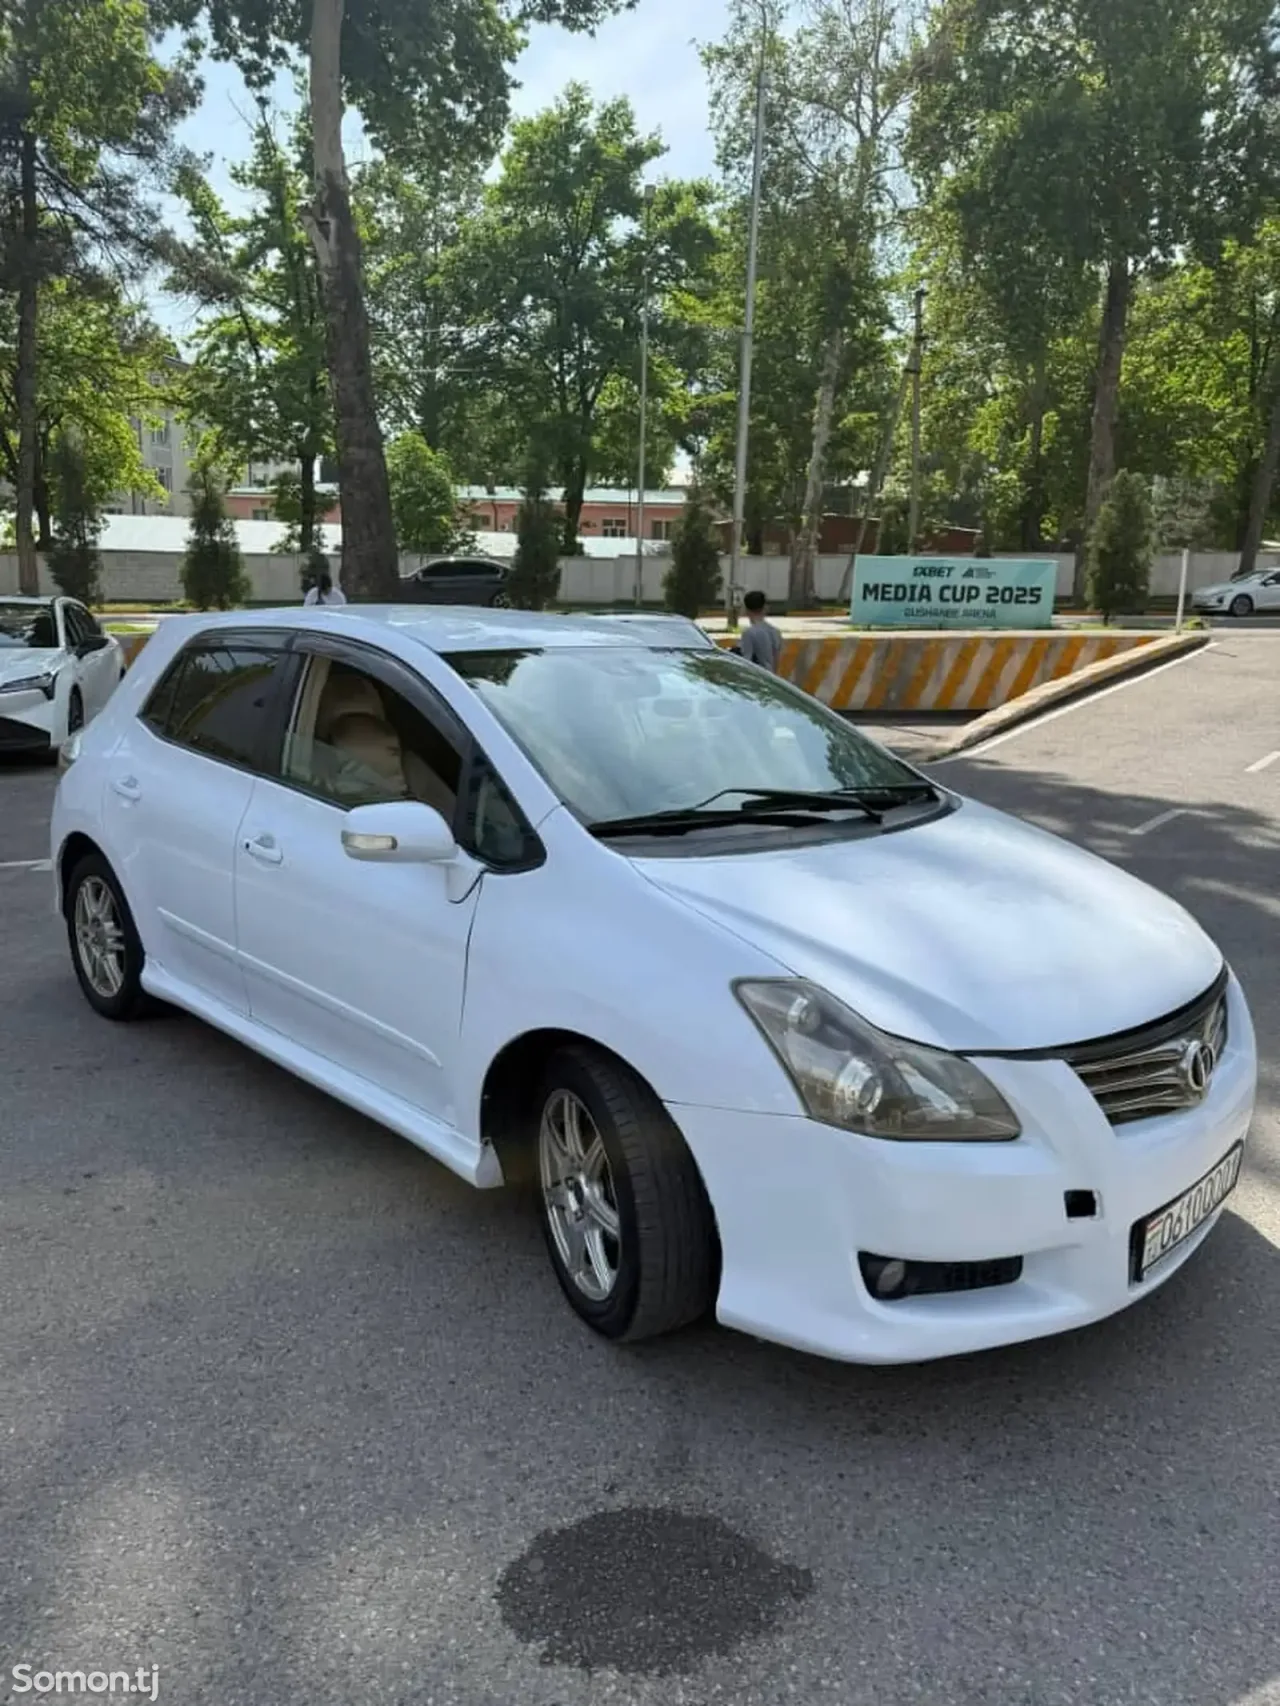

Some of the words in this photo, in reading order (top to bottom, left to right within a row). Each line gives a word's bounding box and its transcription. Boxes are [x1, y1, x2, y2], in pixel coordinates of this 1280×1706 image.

[862, 583, 932, 602] MEDIA
[939, 584, 980, 603] CUP
[986, 586, 1042, 604] 2025
